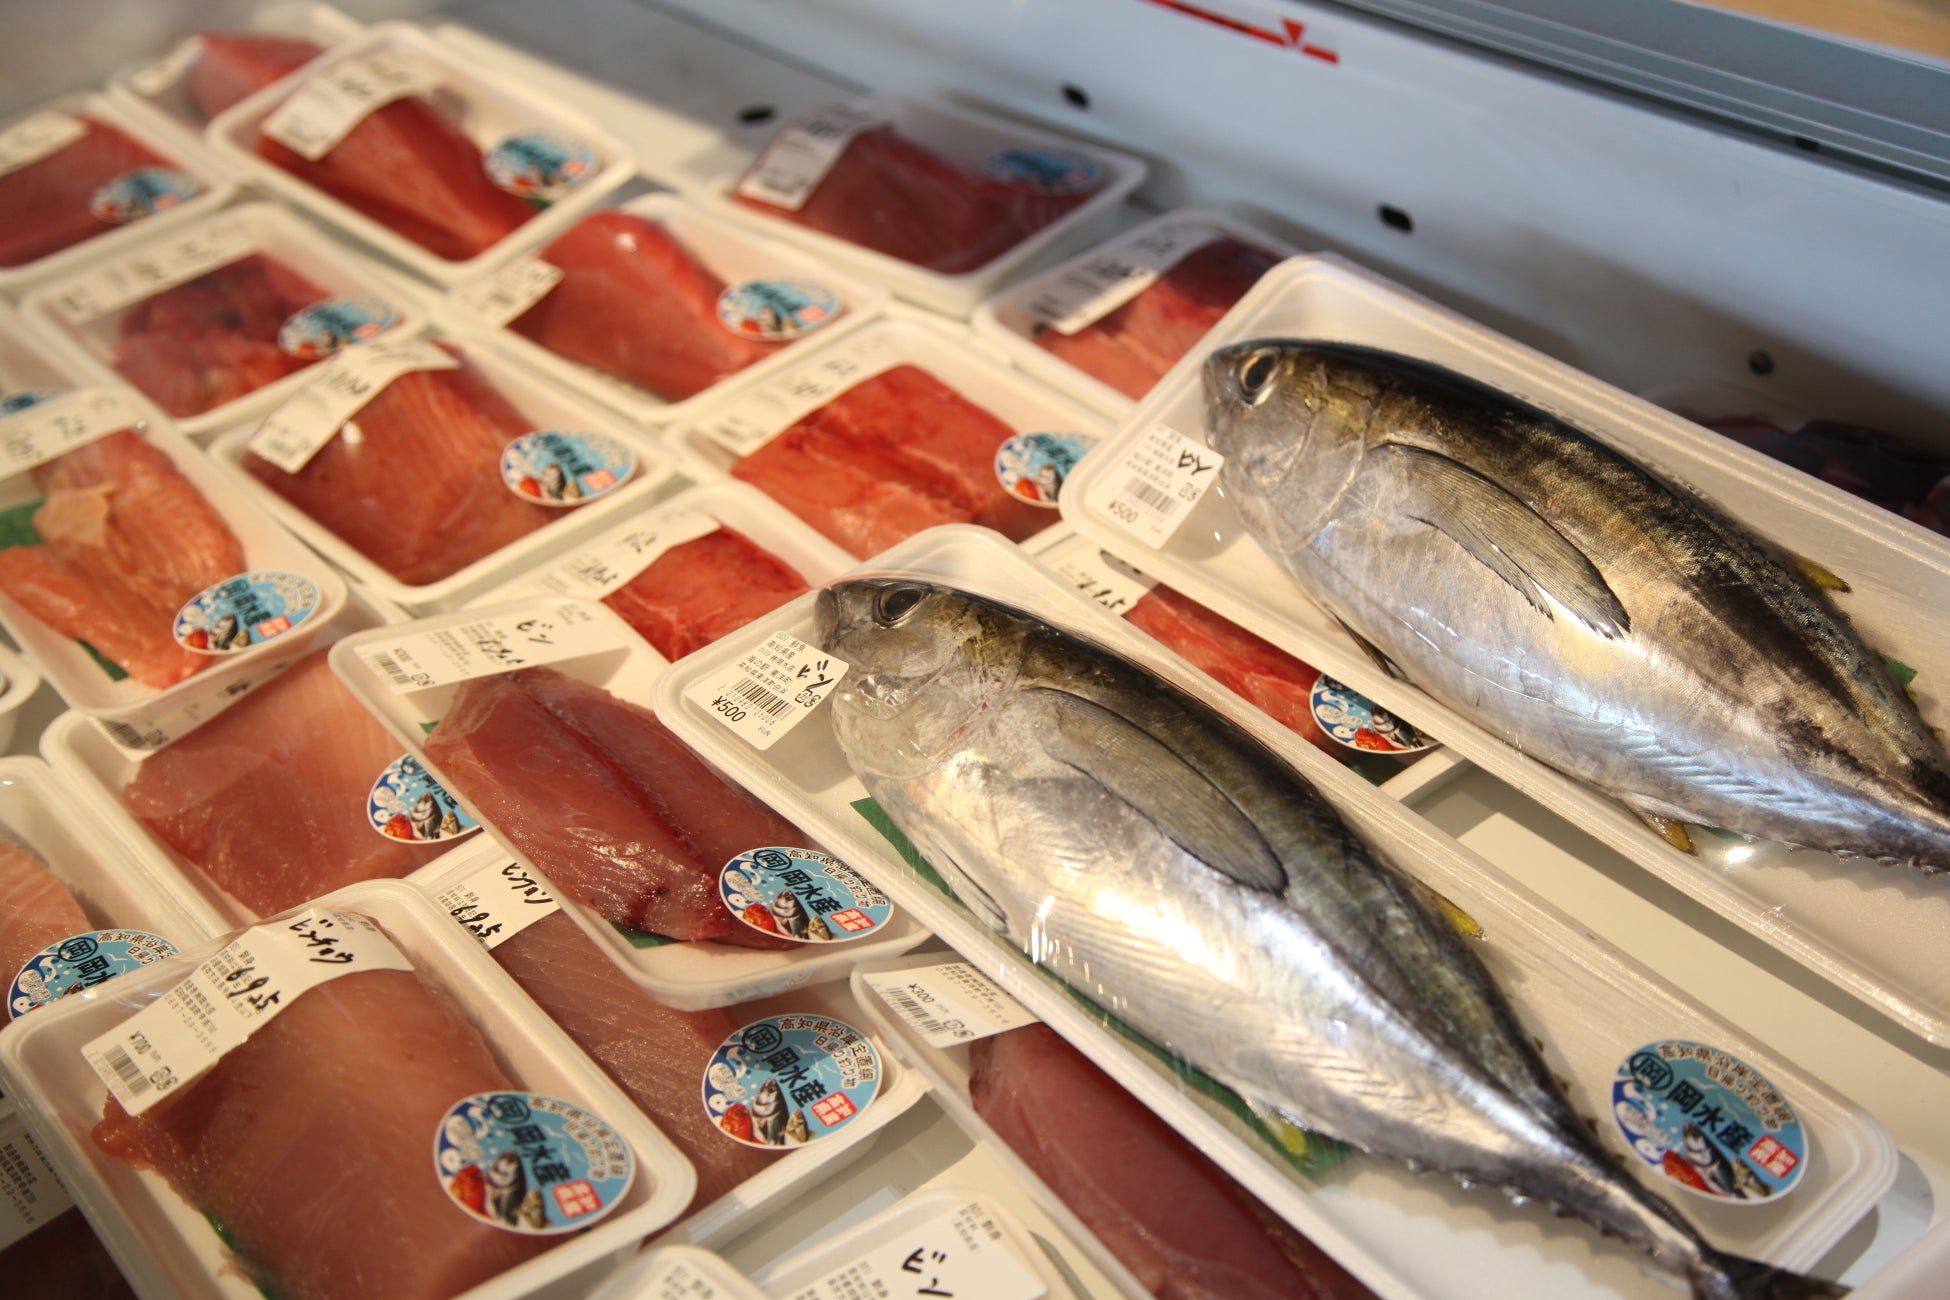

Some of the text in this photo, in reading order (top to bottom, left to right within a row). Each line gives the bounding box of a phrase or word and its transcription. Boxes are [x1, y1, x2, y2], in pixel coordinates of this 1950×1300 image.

[711, 695, 746, 722] ¥500
[776, 870, 843, 915] 岡水産
[908, 983, 936, 1004] ¥300
[128, 1029, 151, 1054] ¥700
[779, 1018, 876, 1081] 高知県沿岸定置網
[762, 1046, 828, 1108] 岡水産
[1666, 1080, 1754, 1154] 岡水産
[508, 1123, 571, 1186] 岡水産
